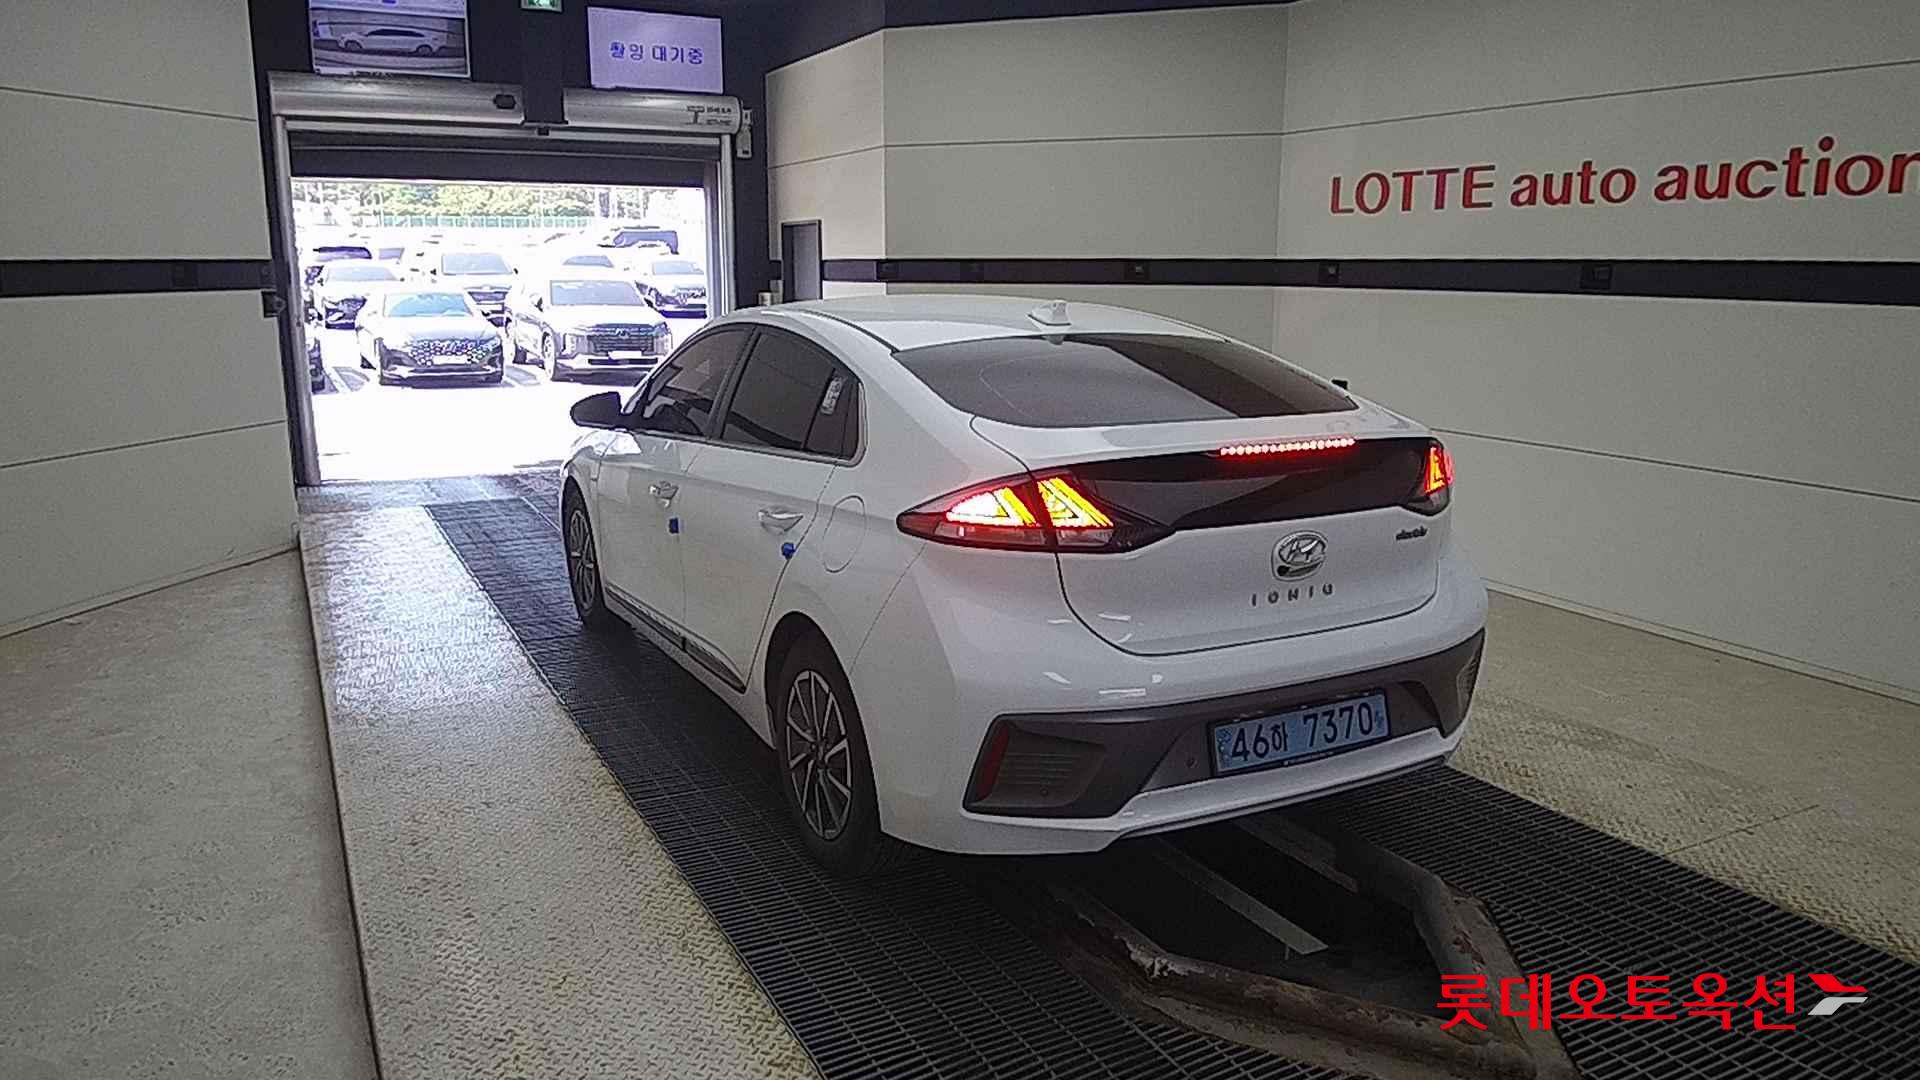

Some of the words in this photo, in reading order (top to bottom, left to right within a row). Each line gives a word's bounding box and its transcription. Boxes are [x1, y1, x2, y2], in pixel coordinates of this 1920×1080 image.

[652, 45, 704, 65] 대기중
[1330, 164, 1496, 215] LOTTE
[1509, 160, 1637, 208] auto
[1251, 583, 1333, 607] IONIQ
[1231, 721, 1289, 762] 46하
[1302, 702, 1373, 748] 7370
